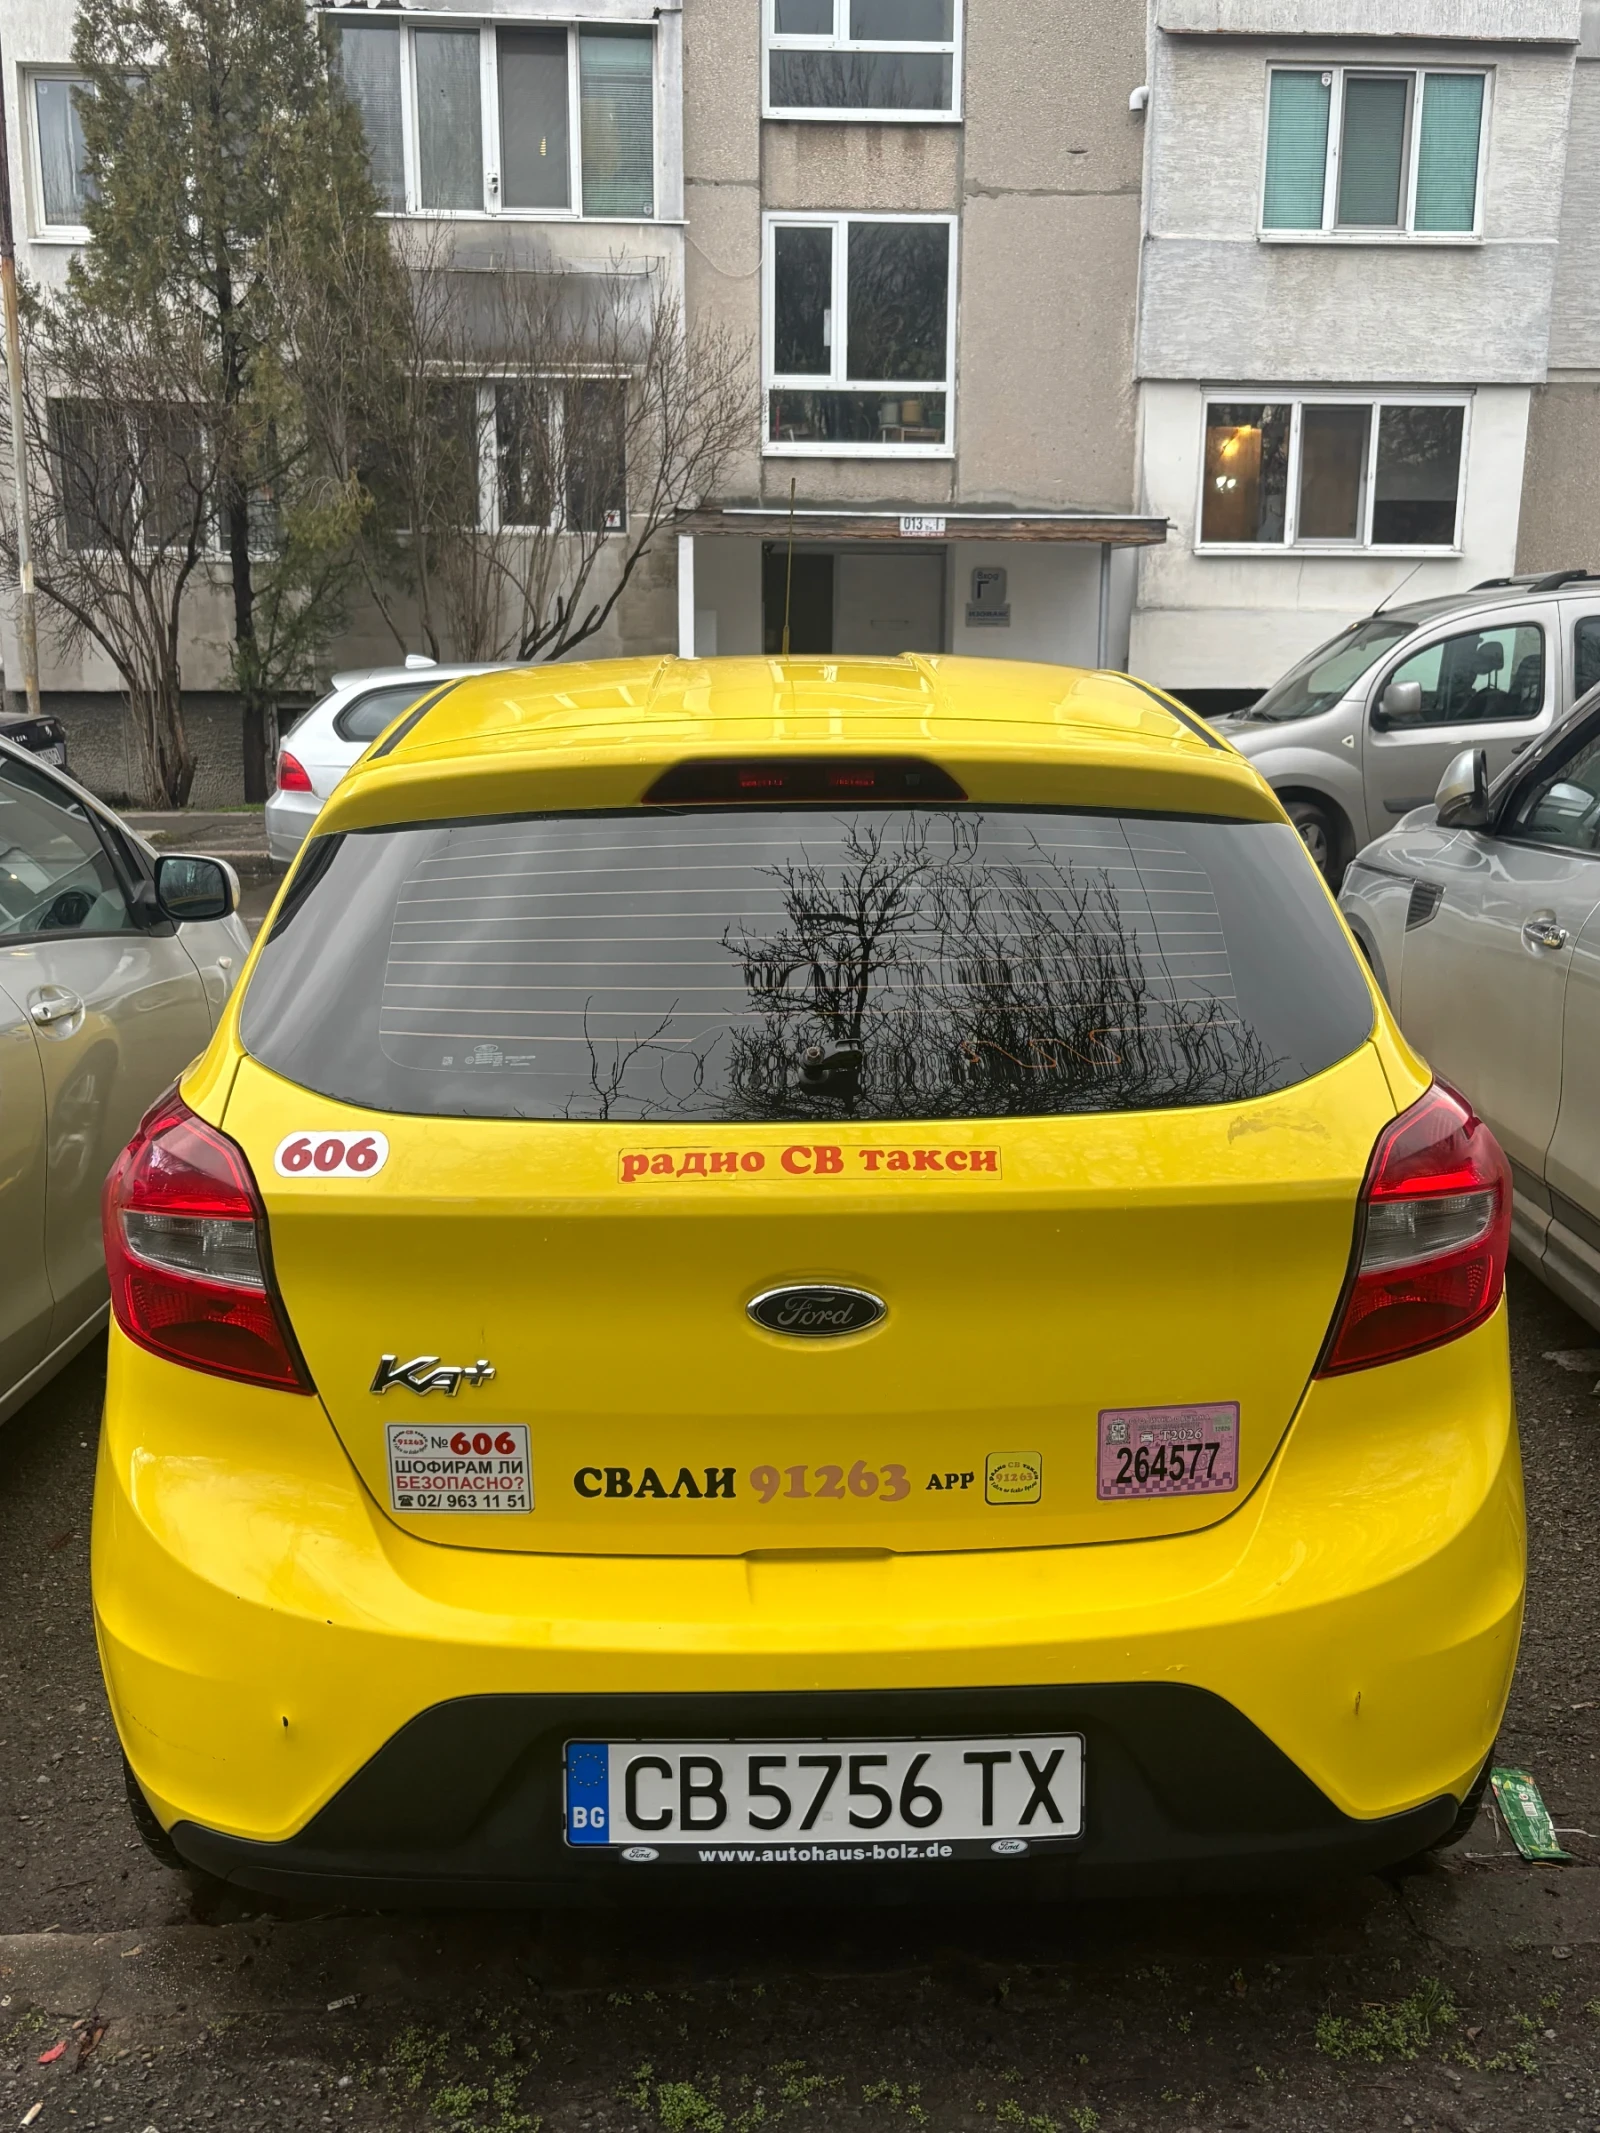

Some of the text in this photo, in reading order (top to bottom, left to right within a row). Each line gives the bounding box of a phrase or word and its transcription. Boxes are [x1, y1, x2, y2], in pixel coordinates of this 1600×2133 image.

[977, 580, 990, 599] Г
[281, 1137, 379, 1172] 606
[620, 1146, 999, 1182] радио СВ такси
[777, 1296, 855, 1325] Ford
[397, 1438, 424, 1446] 91263
[395, 1460, 523, 1474] ШОФИРАМ ЛИ
[1116, 1441, 1221, 1484] 264577
[396, 1475, 524, 1490] БЕЗОПАСНО?
[573, 1467, 737, 1498] СВАЛИ
[749, 1460, 911, 1504] 91263
[995, 1472, 1033, 1483] 91263
[417, 1494, 526, 1508] 02/ 963 11 51
[624, 1749, 1066, 1831] CB 5756 TX
[572, 1806, 605, 1829] BG
[628, 1848, 651, 1860] Ford
[698, 1842, 953, 1863] www.autohaus-bolz.de
[997, 1839, 1021, 1851] Ford
